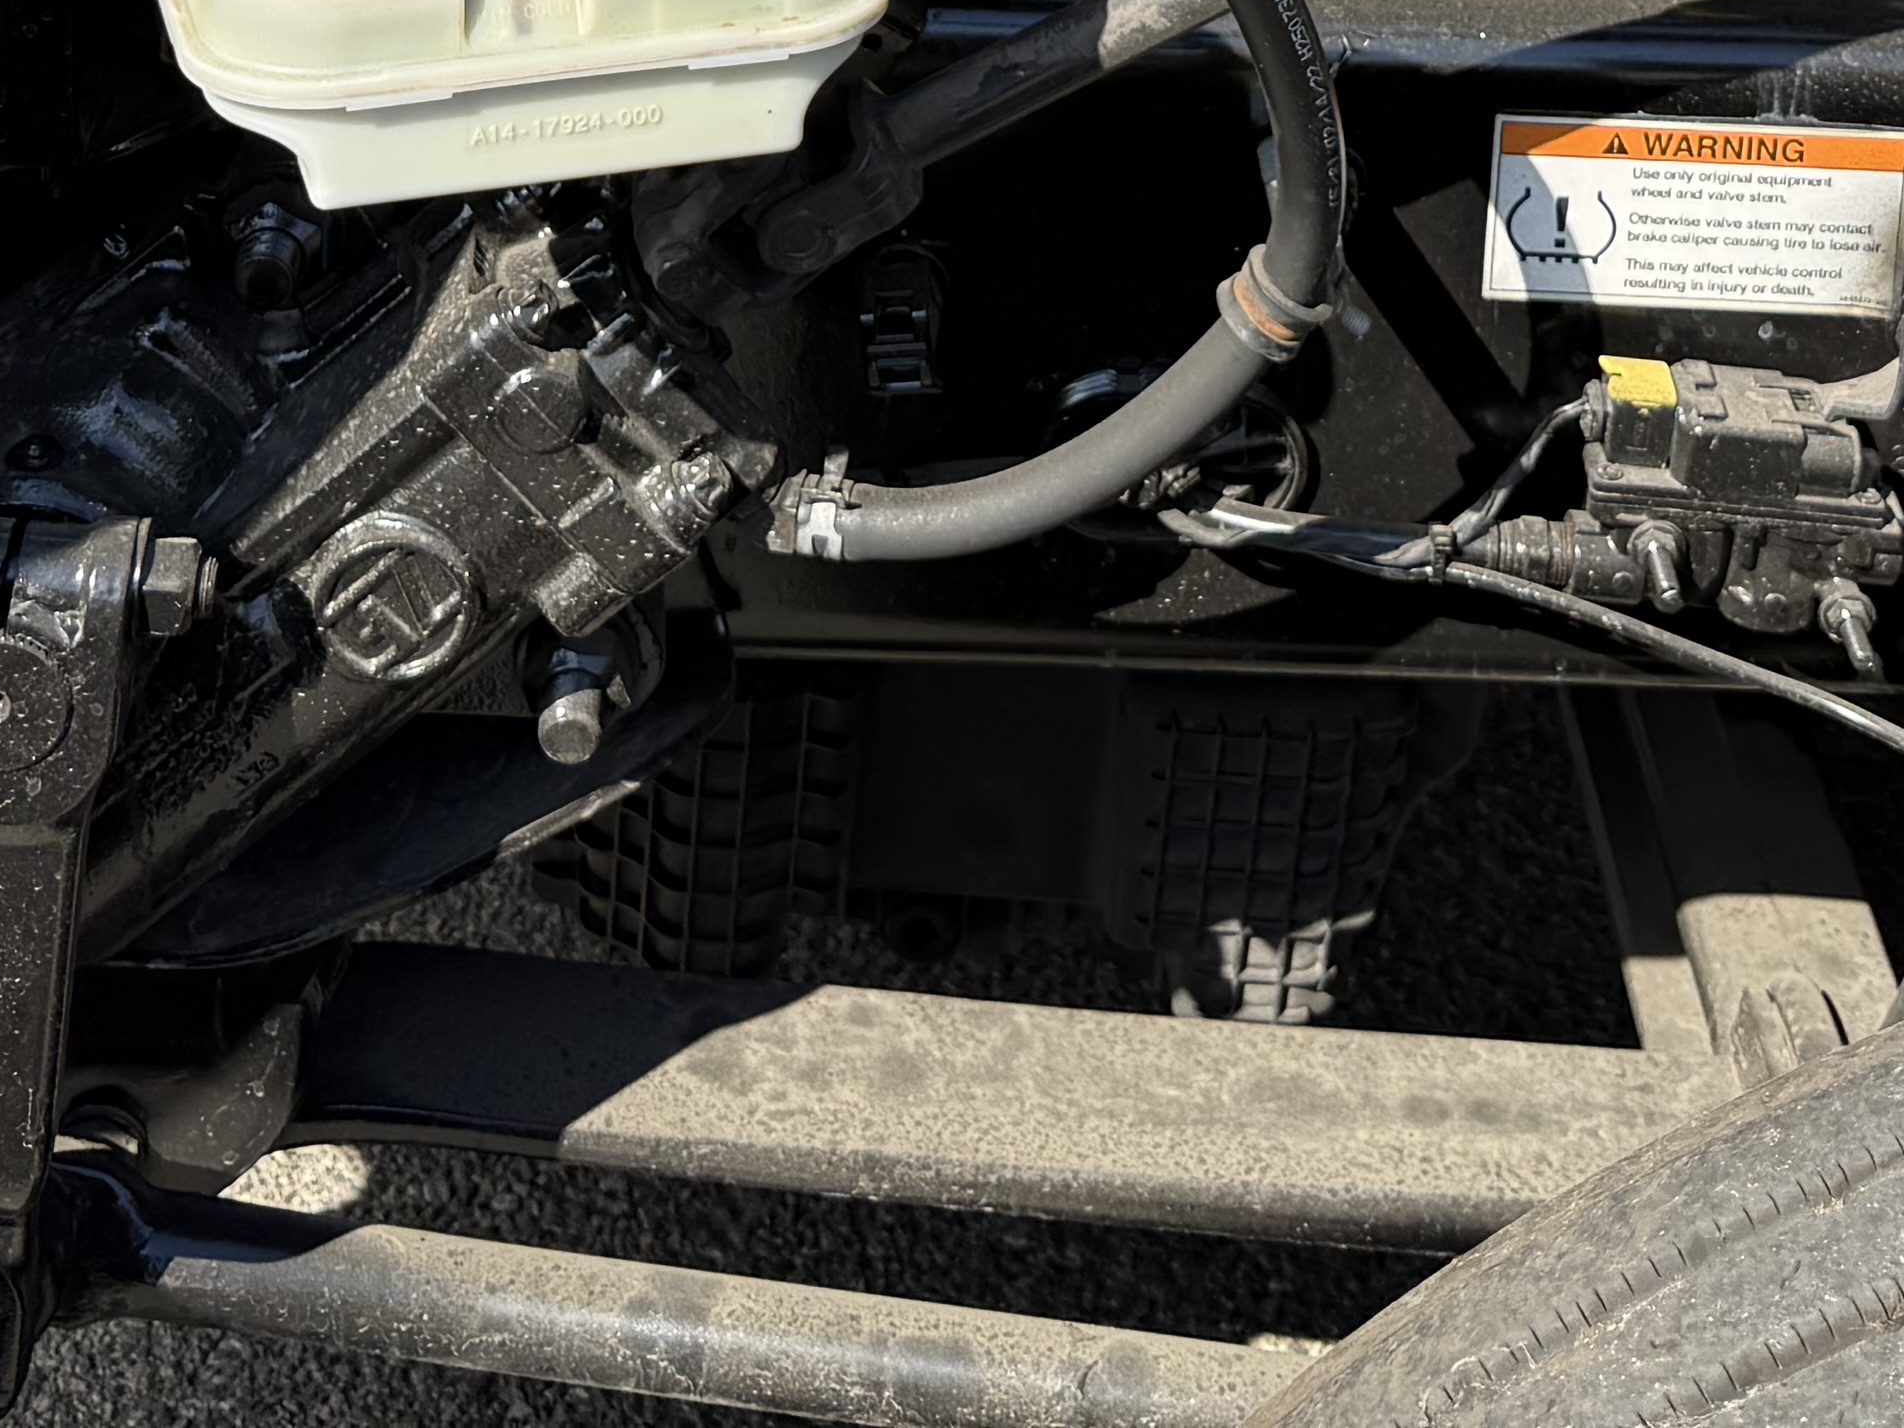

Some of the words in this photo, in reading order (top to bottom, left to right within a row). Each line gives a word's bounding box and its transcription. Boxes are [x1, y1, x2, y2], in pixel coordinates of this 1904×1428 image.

[470, 103, 663, 146] A14-17924-000
[1643, 132, 1805, 163] WARNING
[1633, 168, 1660, 180] Use
[1663, 170, 1695, 184] only
[1698, 171, 1752, 186] original
[1757, 175, 1833, 189] equipment
[1631, 186, 1671, 199] wheel
[1676, 189, 1702, 200] and
[1707, 191, 1745, 202] valve
[1629, 212, 1701, 226] Otherwise
[1705, 217, 1743, 229] valve
[1747, 219, 1781, 231] stem
[1785, 221, 1815, 235] may
[1819, 223, 1872, 235] contact
[1627, 230, 1668, 243] brake
[1671, 233, 1719, 247] caliper
[1723, 236, 1779, 250] causing
[1784, 237, 1807, 249] tire
[1811, 239, 1826, 250] to
[1829, 239, 1860, 251] lose
[1863, 241, 1887, 253] air.
[1626, 258, 1655, 271] This
[1659, 261, 1689, 275] may
[1693, 261, 1734, 274] affect
[1738, 263, 1787, 277] vehicle
[1791, 266, 1843, 279] control
[1623, 278, 1686, 293] resulting
[1690, 280, 1703, 291] in
[1707, 281, 1748, 295] injury
[1752, 284, 1767, 294] or
[1771, 284, 1815, 296] death.
